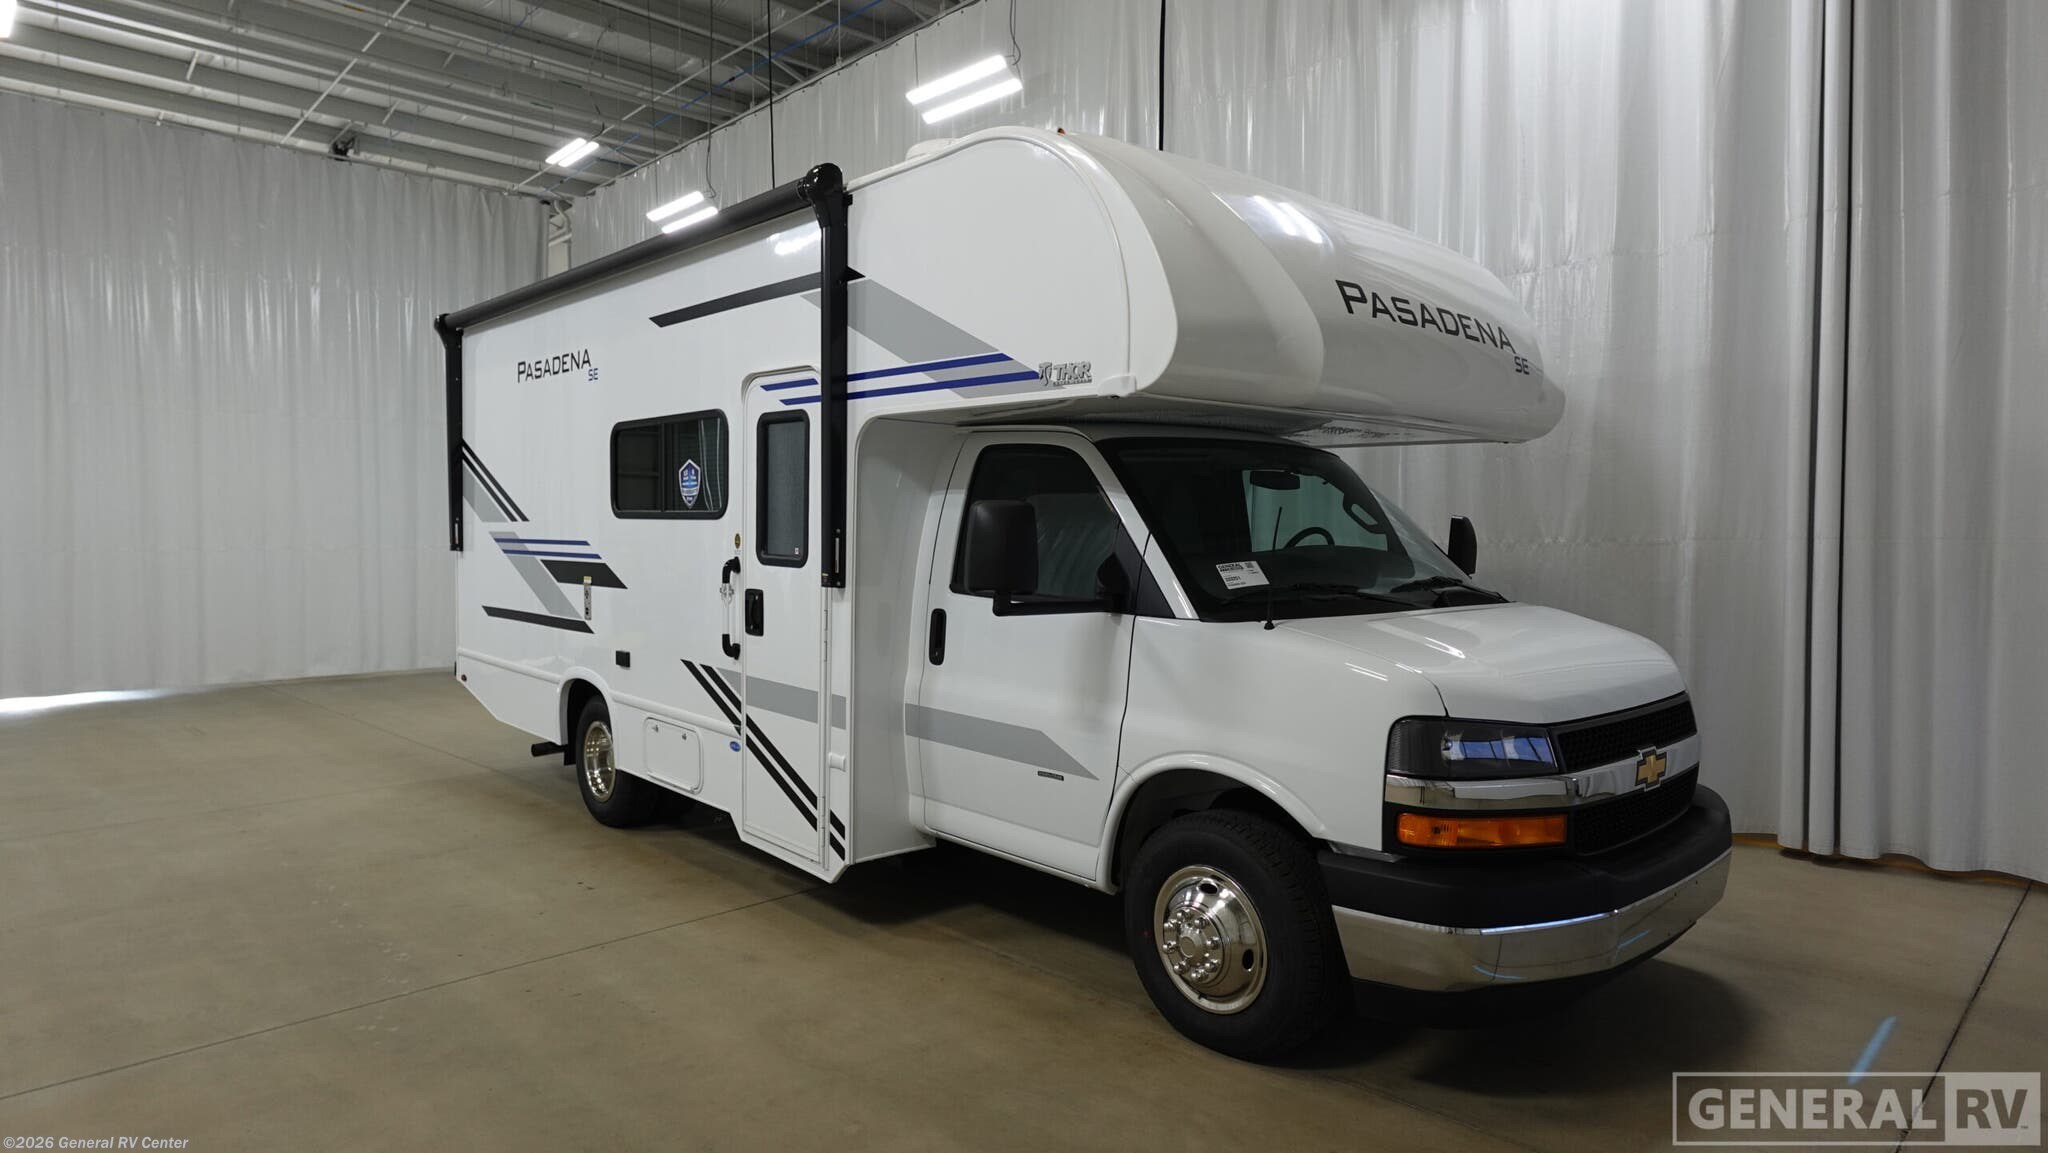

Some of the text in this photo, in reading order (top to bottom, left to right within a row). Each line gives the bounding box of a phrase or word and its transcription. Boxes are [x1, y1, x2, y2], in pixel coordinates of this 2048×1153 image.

[1335, 279, 1516, 354] PASADENA
[517, 348, 592, 383] PASADENA
[588, 367, 599, 381] SE
[1053, 361, 1091, 381] THOR
[1514, 356, 1530, 375] SE
